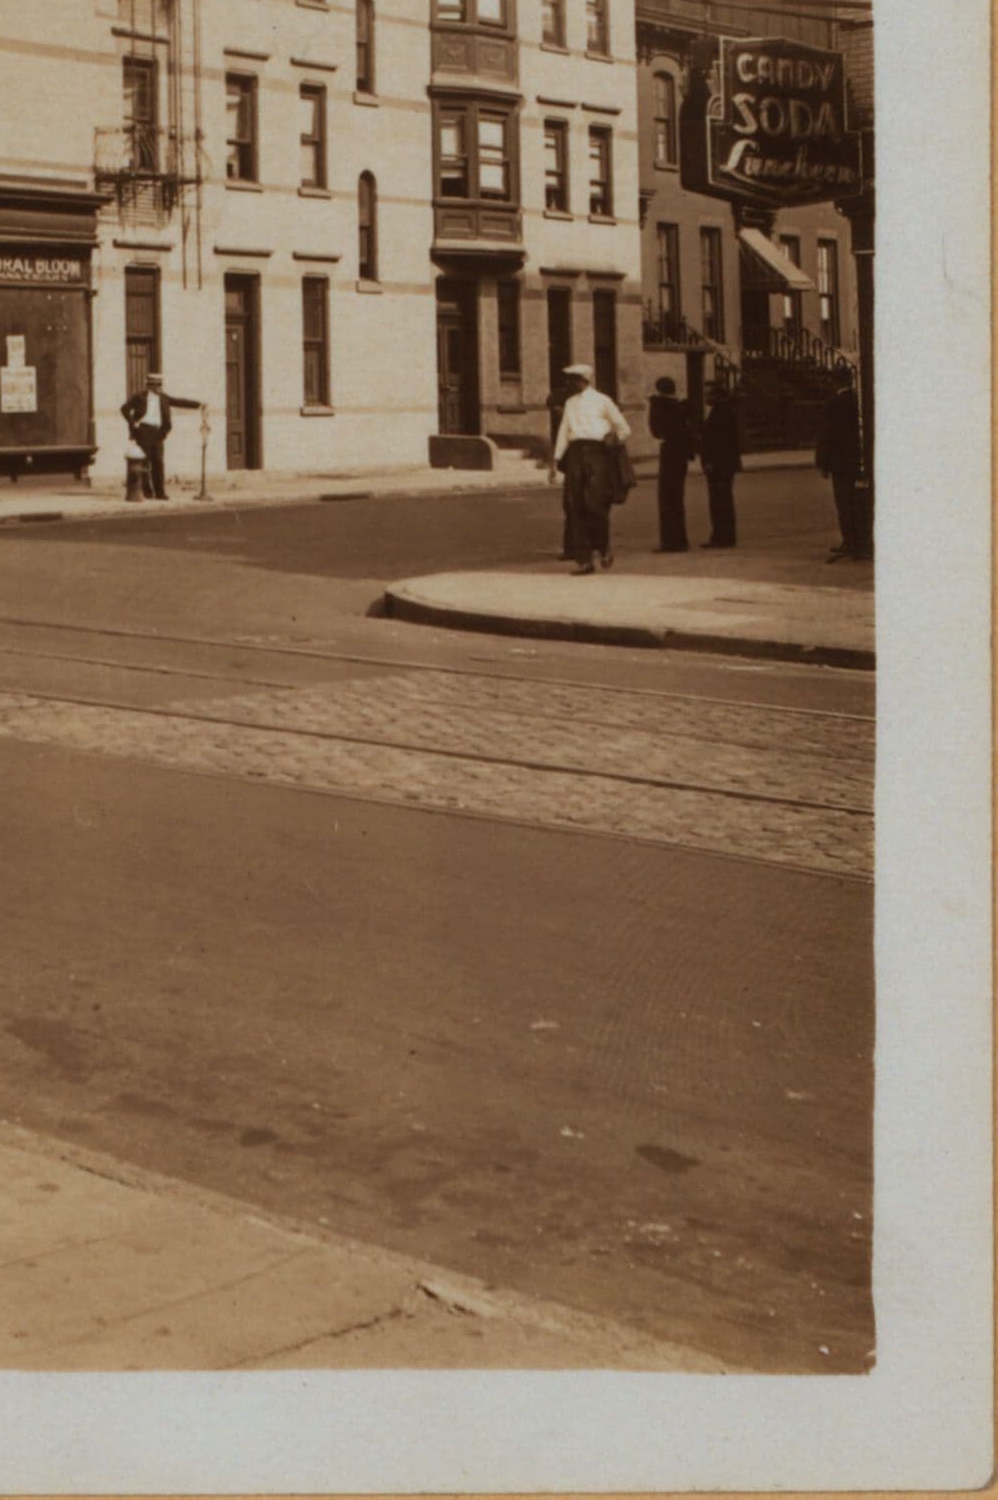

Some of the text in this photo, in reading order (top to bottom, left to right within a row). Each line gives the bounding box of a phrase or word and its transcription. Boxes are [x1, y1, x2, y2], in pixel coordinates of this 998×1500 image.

[736, 52, 836, 92] CANDY
[732, 92, 841, 143] SODA
[36, 259, 81, 277] BLOOM
